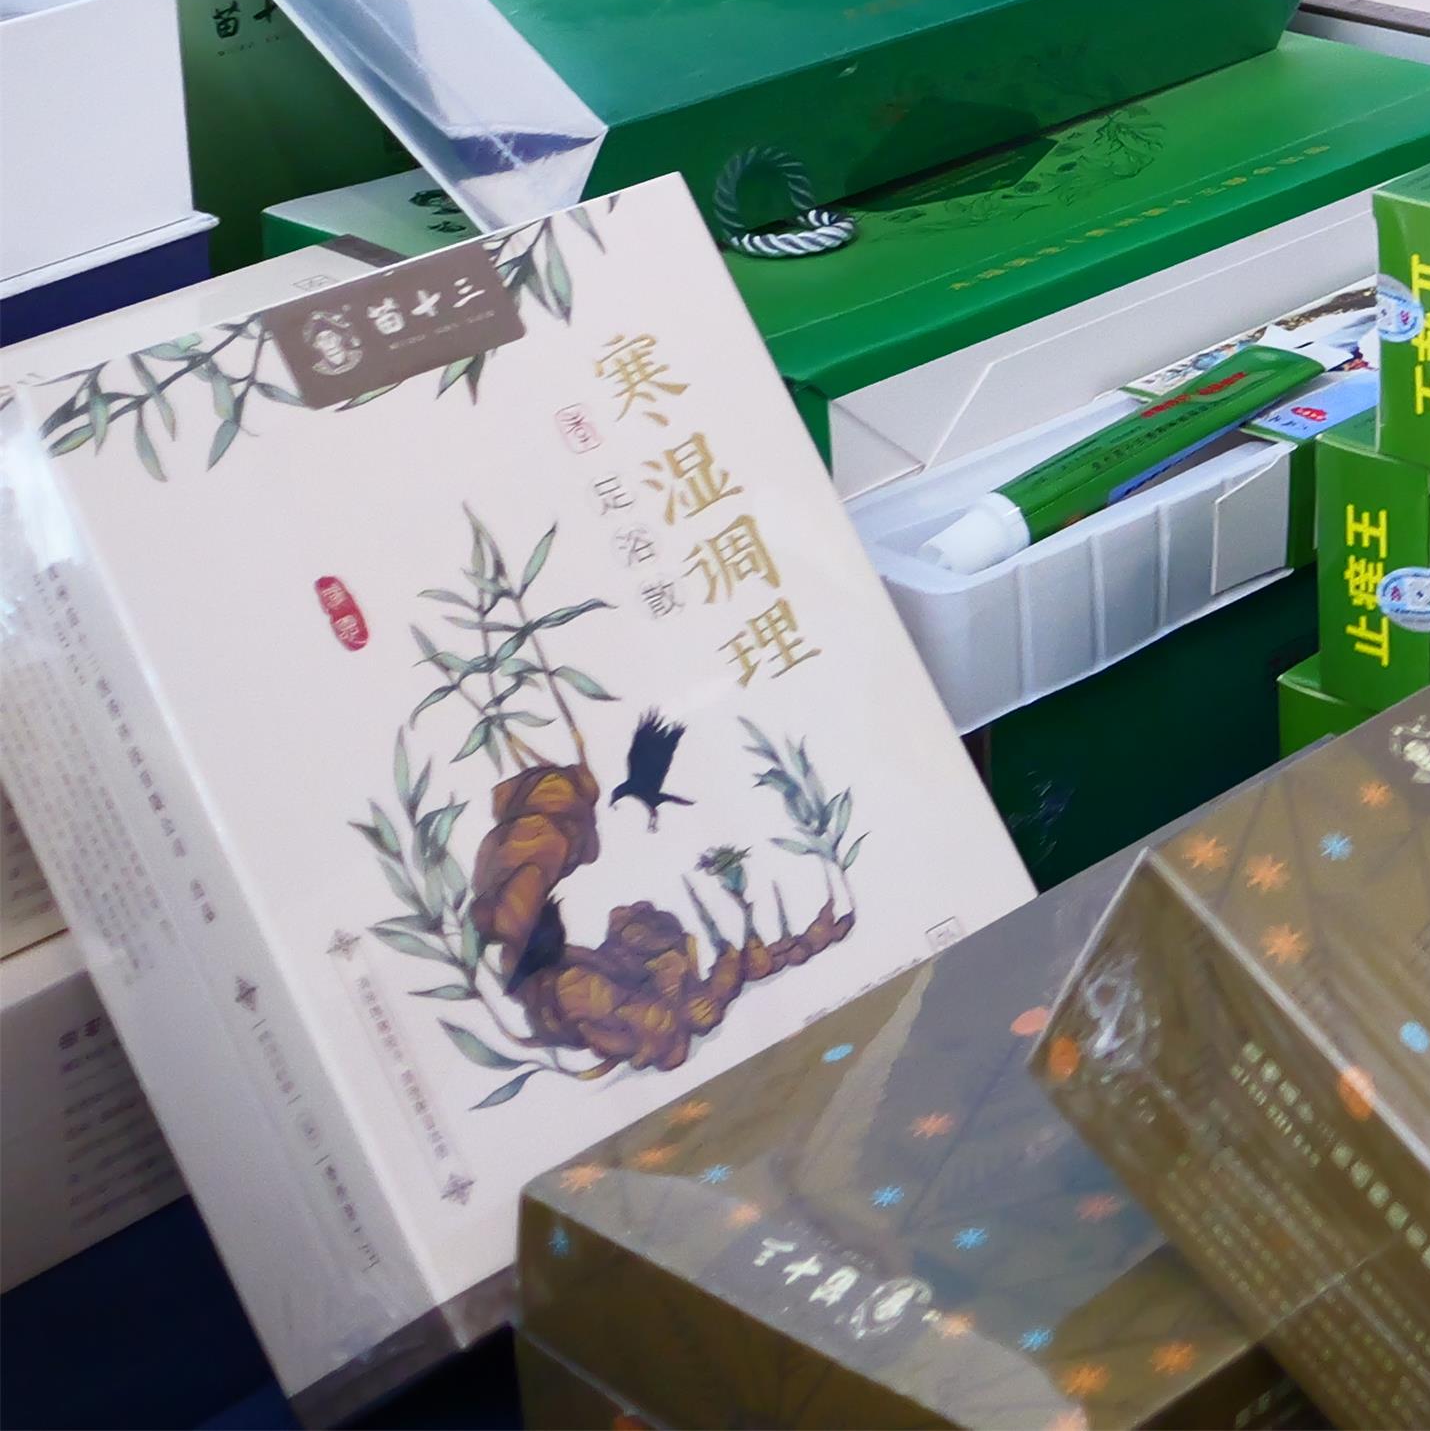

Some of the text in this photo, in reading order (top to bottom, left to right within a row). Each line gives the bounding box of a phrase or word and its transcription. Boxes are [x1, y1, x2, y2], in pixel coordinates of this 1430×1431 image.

[366, 276, 486, 336] 苗十三
[592, 333, 823, 689] 寒湿调理
[1343, 503, 1390, 667] 止痒王
